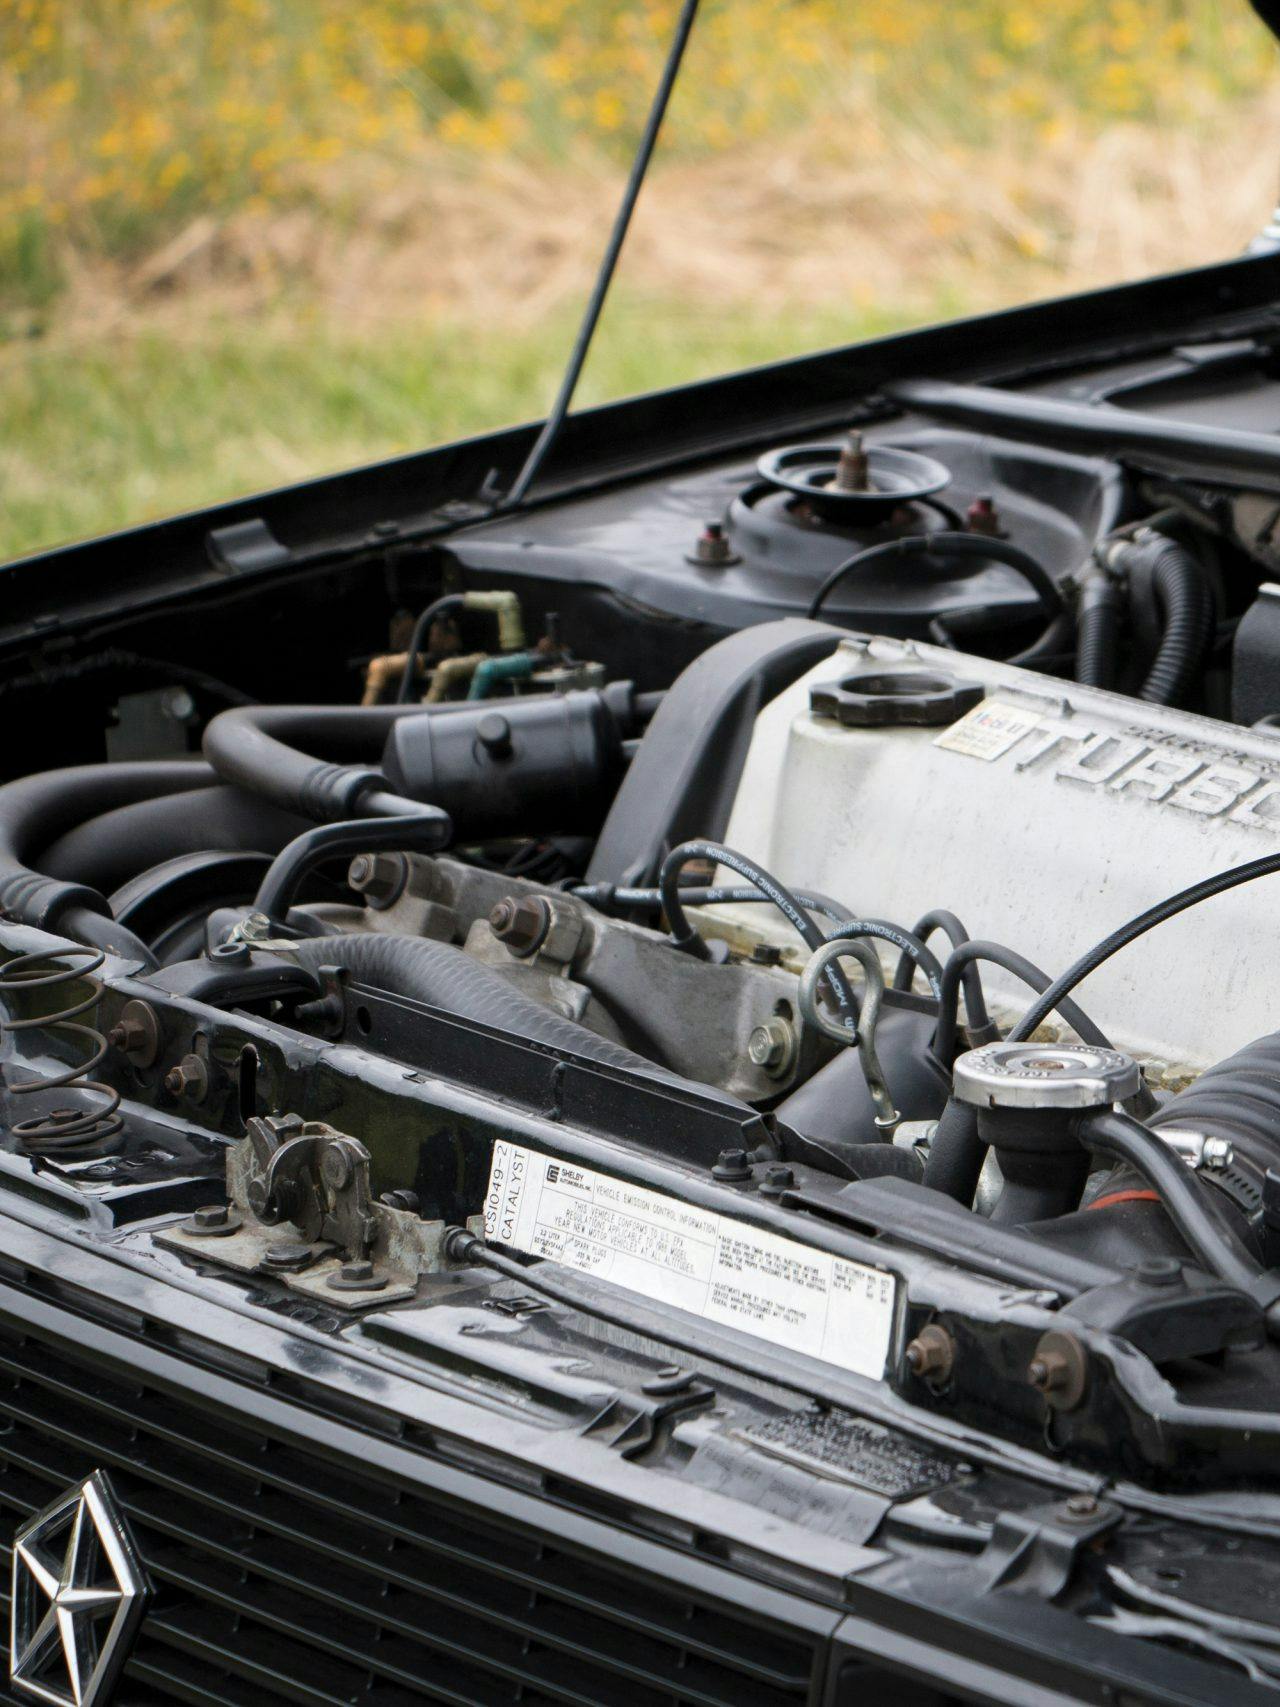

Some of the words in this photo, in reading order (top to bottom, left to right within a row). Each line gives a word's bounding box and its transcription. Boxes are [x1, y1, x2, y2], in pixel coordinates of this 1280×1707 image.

[705, 846, 759, 881] SUPPRESSION
[757, 876, 808, 931] ELECTRONIC
[863, 921, 919, 957] ELECTRONIC
[561, 1168, 585, 1181] SHELBY
[501, 1150, 525, 1240] CATALYST
[596, 1184, 621, 1202] VEHICLE
[623, 1193, 650, 1211] EMISSION
[652, 1202, 677, 1220] CONTROL
[679, 1210, 717, 1234] INFORMATION
[554, 1215, 571, 1229] YEAR
[565, 1208, 607, 1230] REGULATIONS
[590, 1205, 616, 1222] VEHICLE
